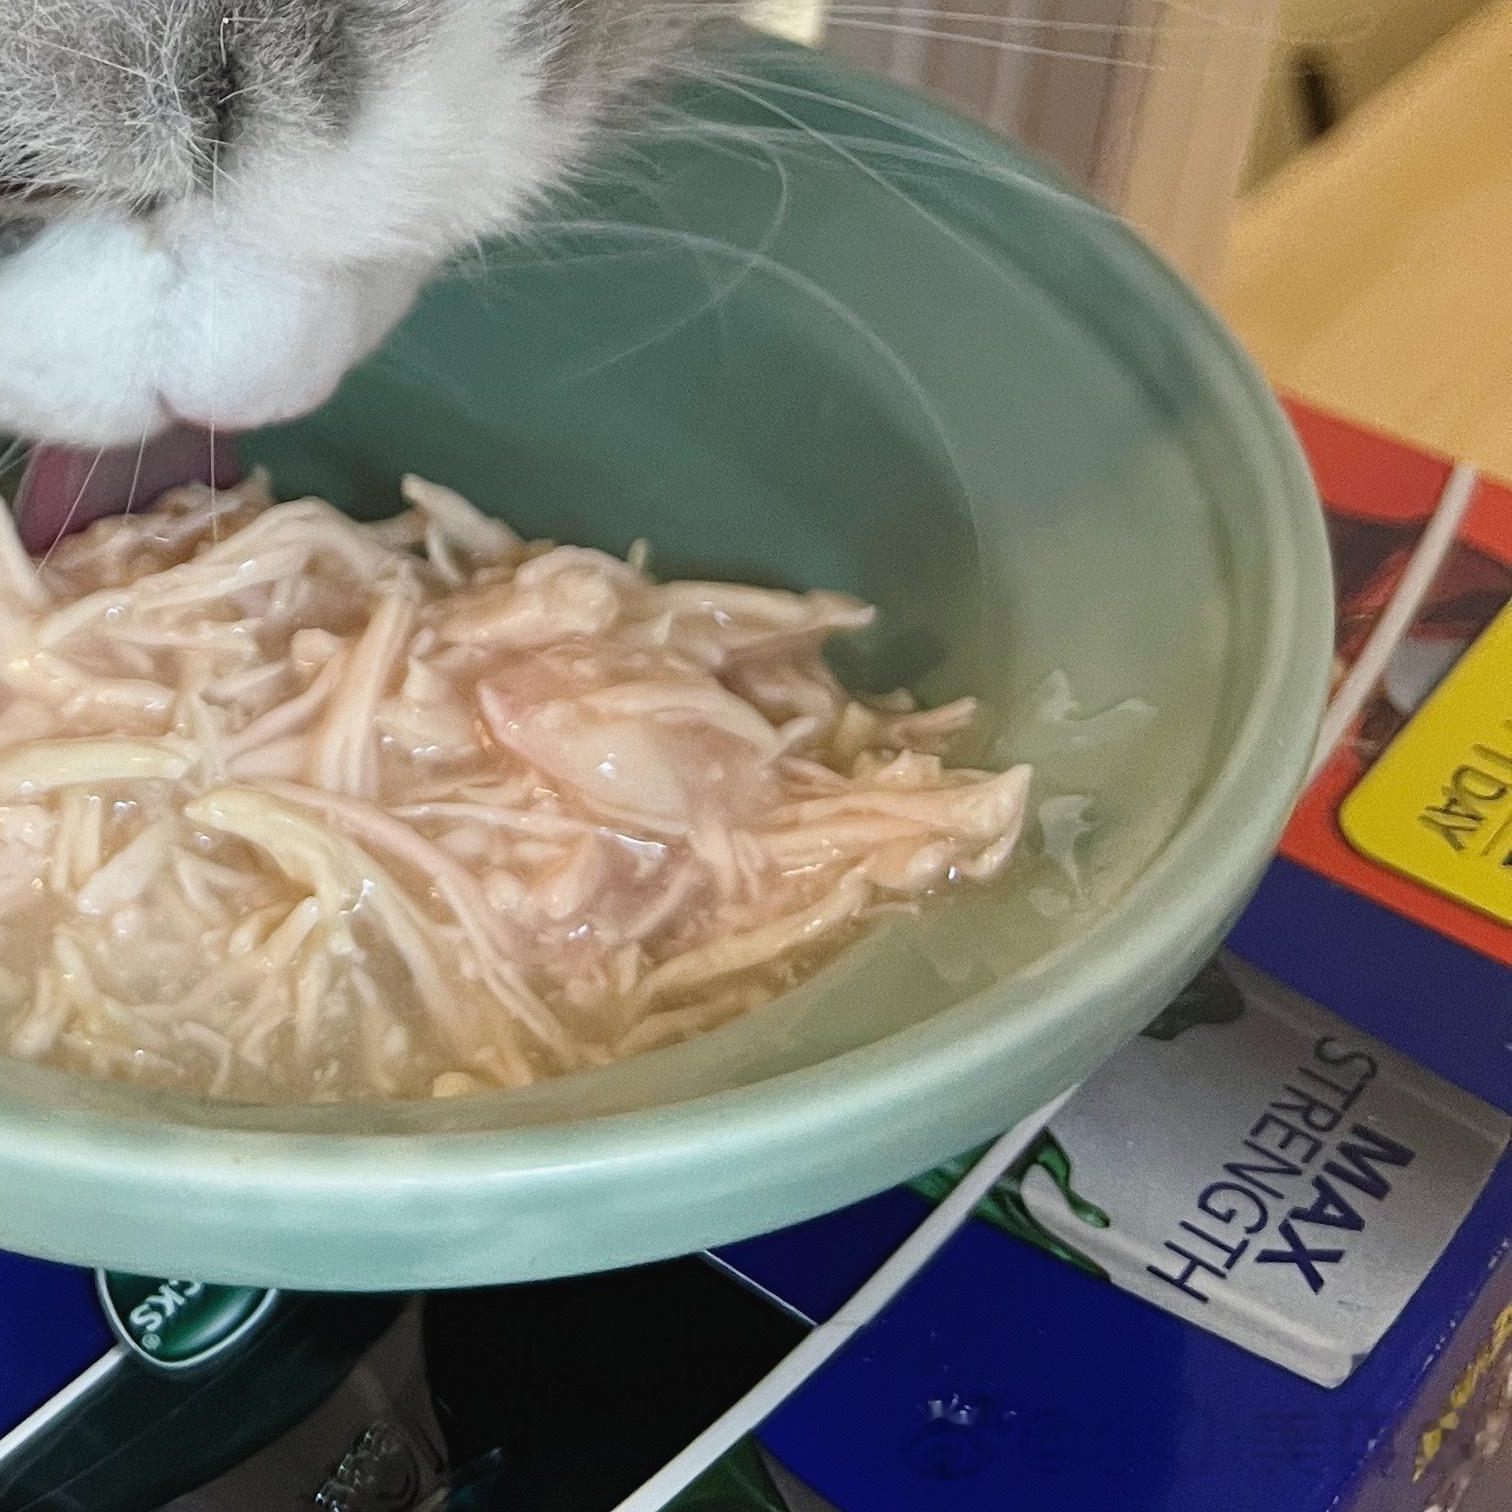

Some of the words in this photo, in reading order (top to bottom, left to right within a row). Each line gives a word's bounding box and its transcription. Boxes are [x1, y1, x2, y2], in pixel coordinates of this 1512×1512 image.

[1146, 1037, 1380, 1304] STRENGTH
[1255, 1124, 1417, 1296] MAX
[130, 1279, 206, 1332] CKS
